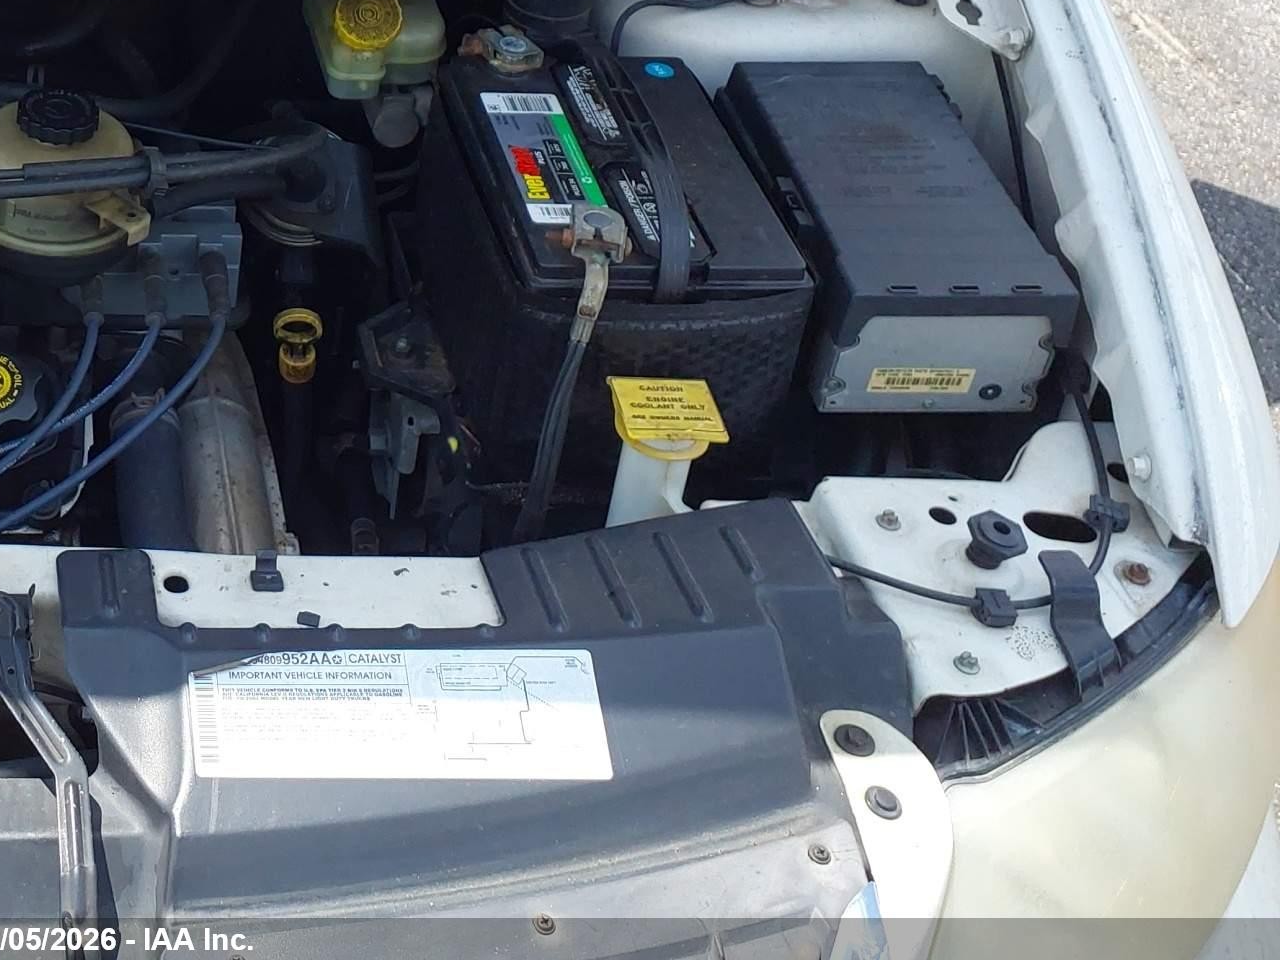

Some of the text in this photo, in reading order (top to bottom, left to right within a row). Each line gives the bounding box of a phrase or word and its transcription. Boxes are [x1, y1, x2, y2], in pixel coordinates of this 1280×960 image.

[633, 208, 654, 235] DANGER
[13, 374, 23, 388] OIL
[629, 402, 676, 410] COOLANT
[348, 653, 402, 665] CATALYST
[228, 671, 392, 681] IMPORTANT VEHICLE INFORMATION
